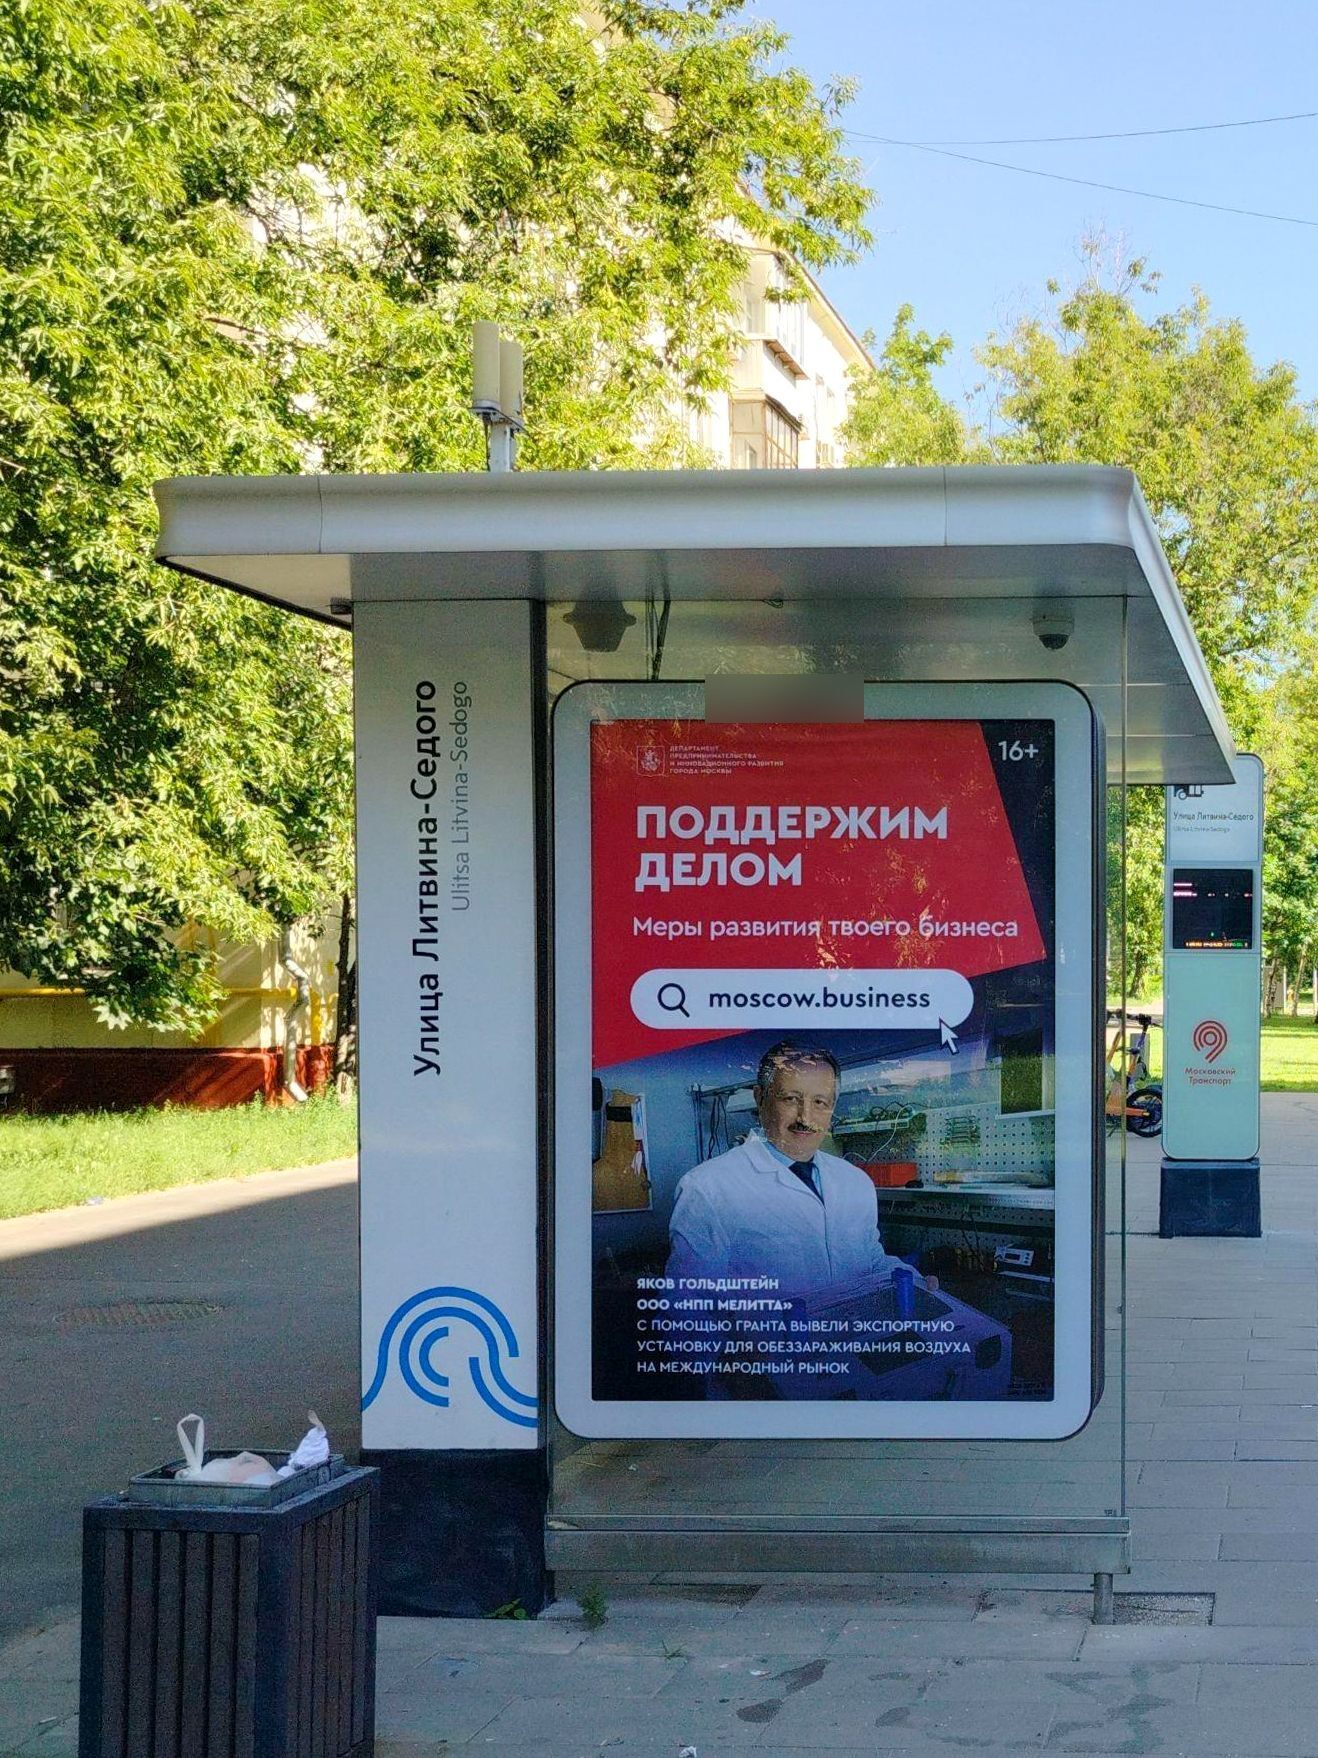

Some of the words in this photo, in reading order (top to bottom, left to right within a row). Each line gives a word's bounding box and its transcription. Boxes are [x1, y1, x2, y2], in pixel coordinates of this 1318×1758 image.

[449, 680, 473, 844] Litvina-Sedogo
[998, 740, 1039, 762] 16+
[410, 679, 442, 962] Литвина-Седого
[636, 805, 949, 845] ПОДДЕРЖИМ
[451, 850, 471, 912] Ulitsa
[635, 852, 803, 892] ДЕЛОМ
[633, 917, 703, 940] Меры
[710, 919, 820, 939] развития
[828, 919, 911, 938] твоего
[919, 916, 1019, 938] бизнеса
[708, 986, 931, 1010] moscow.business
[413, 972, 443, 1077] Улица
[1184, 1067, 1236, 1075] Московский
[1189, 1076, 1232, 1086] Транспорт
[637, 1278, 675, 1291] ЯКОВ
[679, 1275, 779, 1293] ГОЛЬДШТЕЙН
[637, 1299, 669, 1311] ООО
[673, 1299, 713, 1311] «НПП
[717, 1299, 793, 1311] МЕЛИТТА»
[637, 1320, 647, 1332] С
[651, 1320, 732, 1335] ПОМОЩЬЮ
[736, 1320, 787, 1332] ГРАНТА
[791, 1320, 849, 1332] ВЫВЕЛИ
[853, 1320, 955, 1332] ЭКСПОРТНУЮ
[637, 1341, 721, 1354] УСТАНОВКУ
[725, 1341, 753, 1356] ДЛЯ
[757, 1341, 901, 1354] ОБЕЗЗАРАЖИВАНИЯ
[905, 1341, 971, 1356] ВОЗДУХА
[637, 1362, 656, 1374] НА
[659, 1359, 794, 1376] МЕЖДУНАРОДНЫЙ
[798, 1362, 849, 1374] РЫНОК
